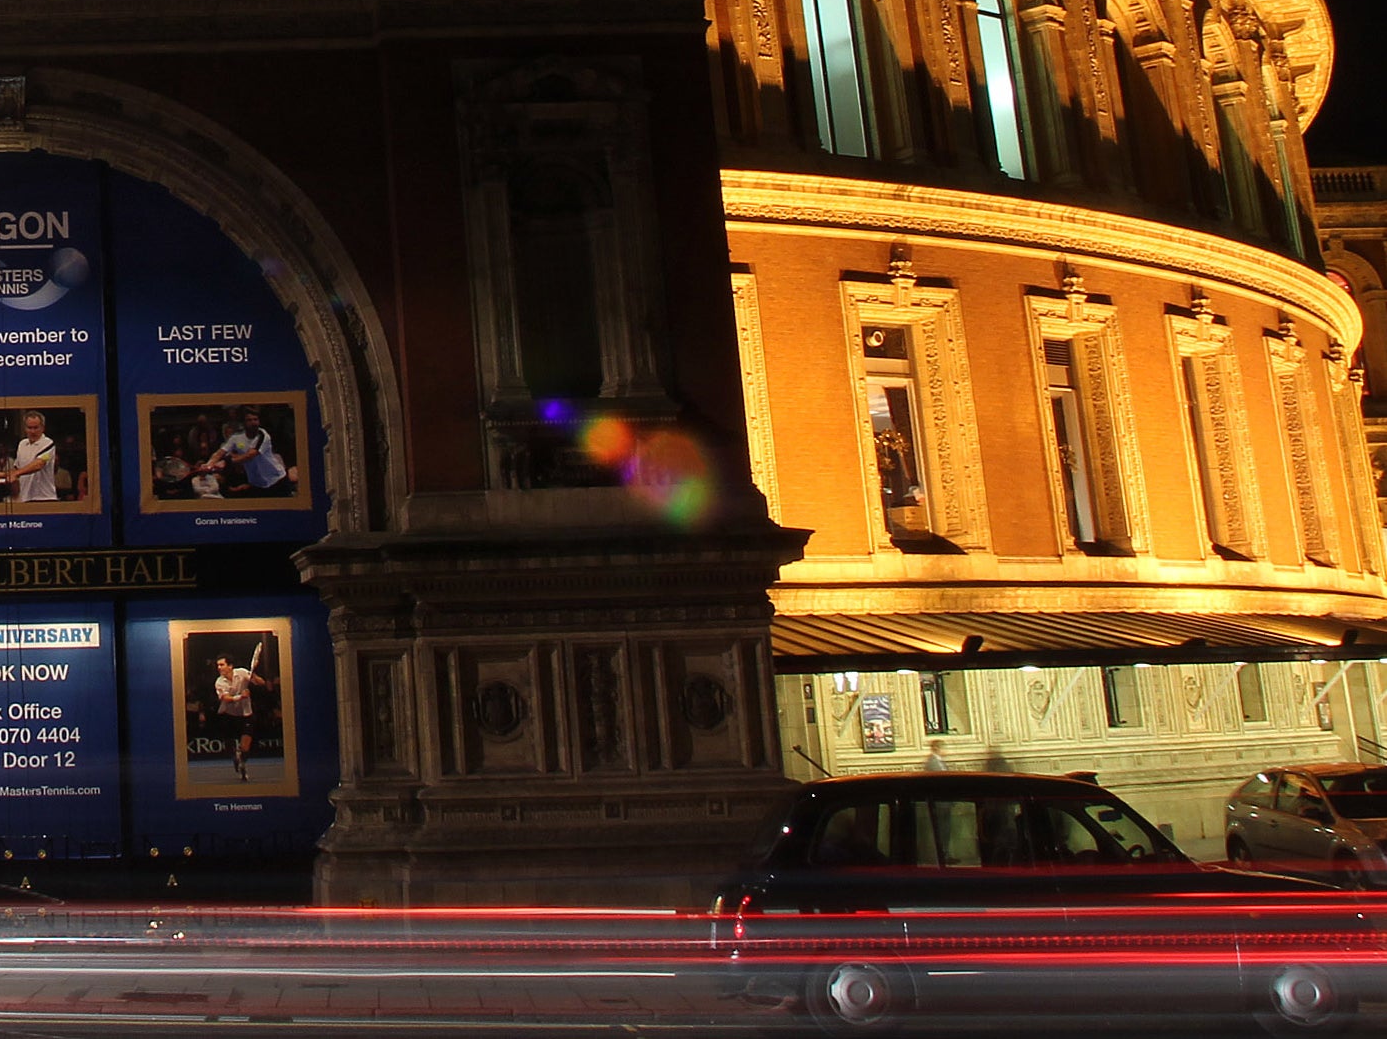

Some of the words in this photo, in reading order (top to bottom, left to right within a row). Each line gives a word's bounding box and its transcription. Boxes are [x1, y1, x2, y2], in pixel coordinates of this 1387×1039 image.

[70, 328, 89, 343] to
[158, 325, 205, 341] LAST
[211, 324, 253, 340] FEW
[162, 347, 249, 364] TICKETS!
[9, 521, 43, 529] McEnroe
[104, 555, 197, 585] HALL
[21, 664, 69, 681] NOW
[8, 703, 63, 720] Office
[36, 726, 81, 743] 4404
[3, 752, 48, 768] Door
[53, 751, 76, 767] 12
[213, 803, 228, 811] Tim
[230, 803, 262, 811] Henman
